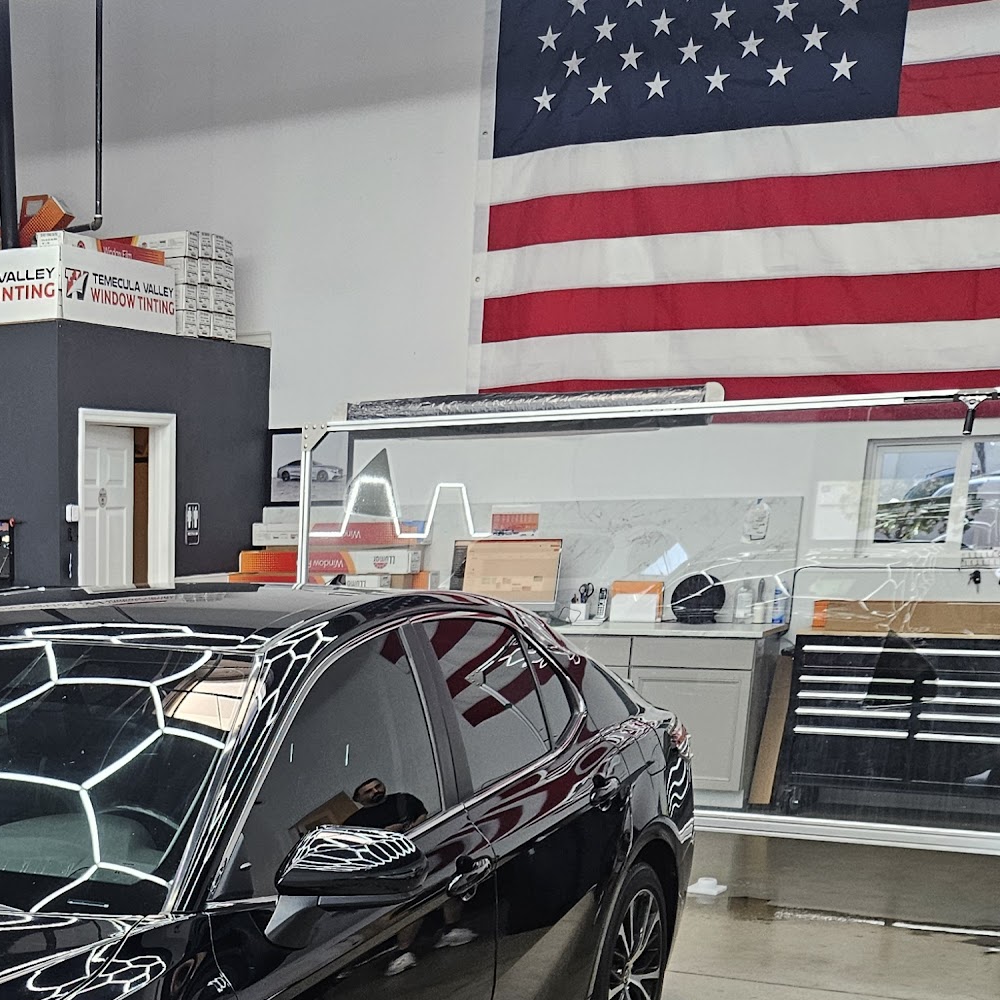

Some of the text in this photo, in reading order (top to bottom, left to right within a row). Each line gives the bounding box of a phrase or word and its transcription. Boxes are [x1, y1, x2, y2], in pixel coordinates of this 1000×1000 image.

[92, 272, 174, 299] TEMECULA VALLEY
[90, 286, 176, 316] WINDOW TINTING
[312, 559, 344, 569] Window
